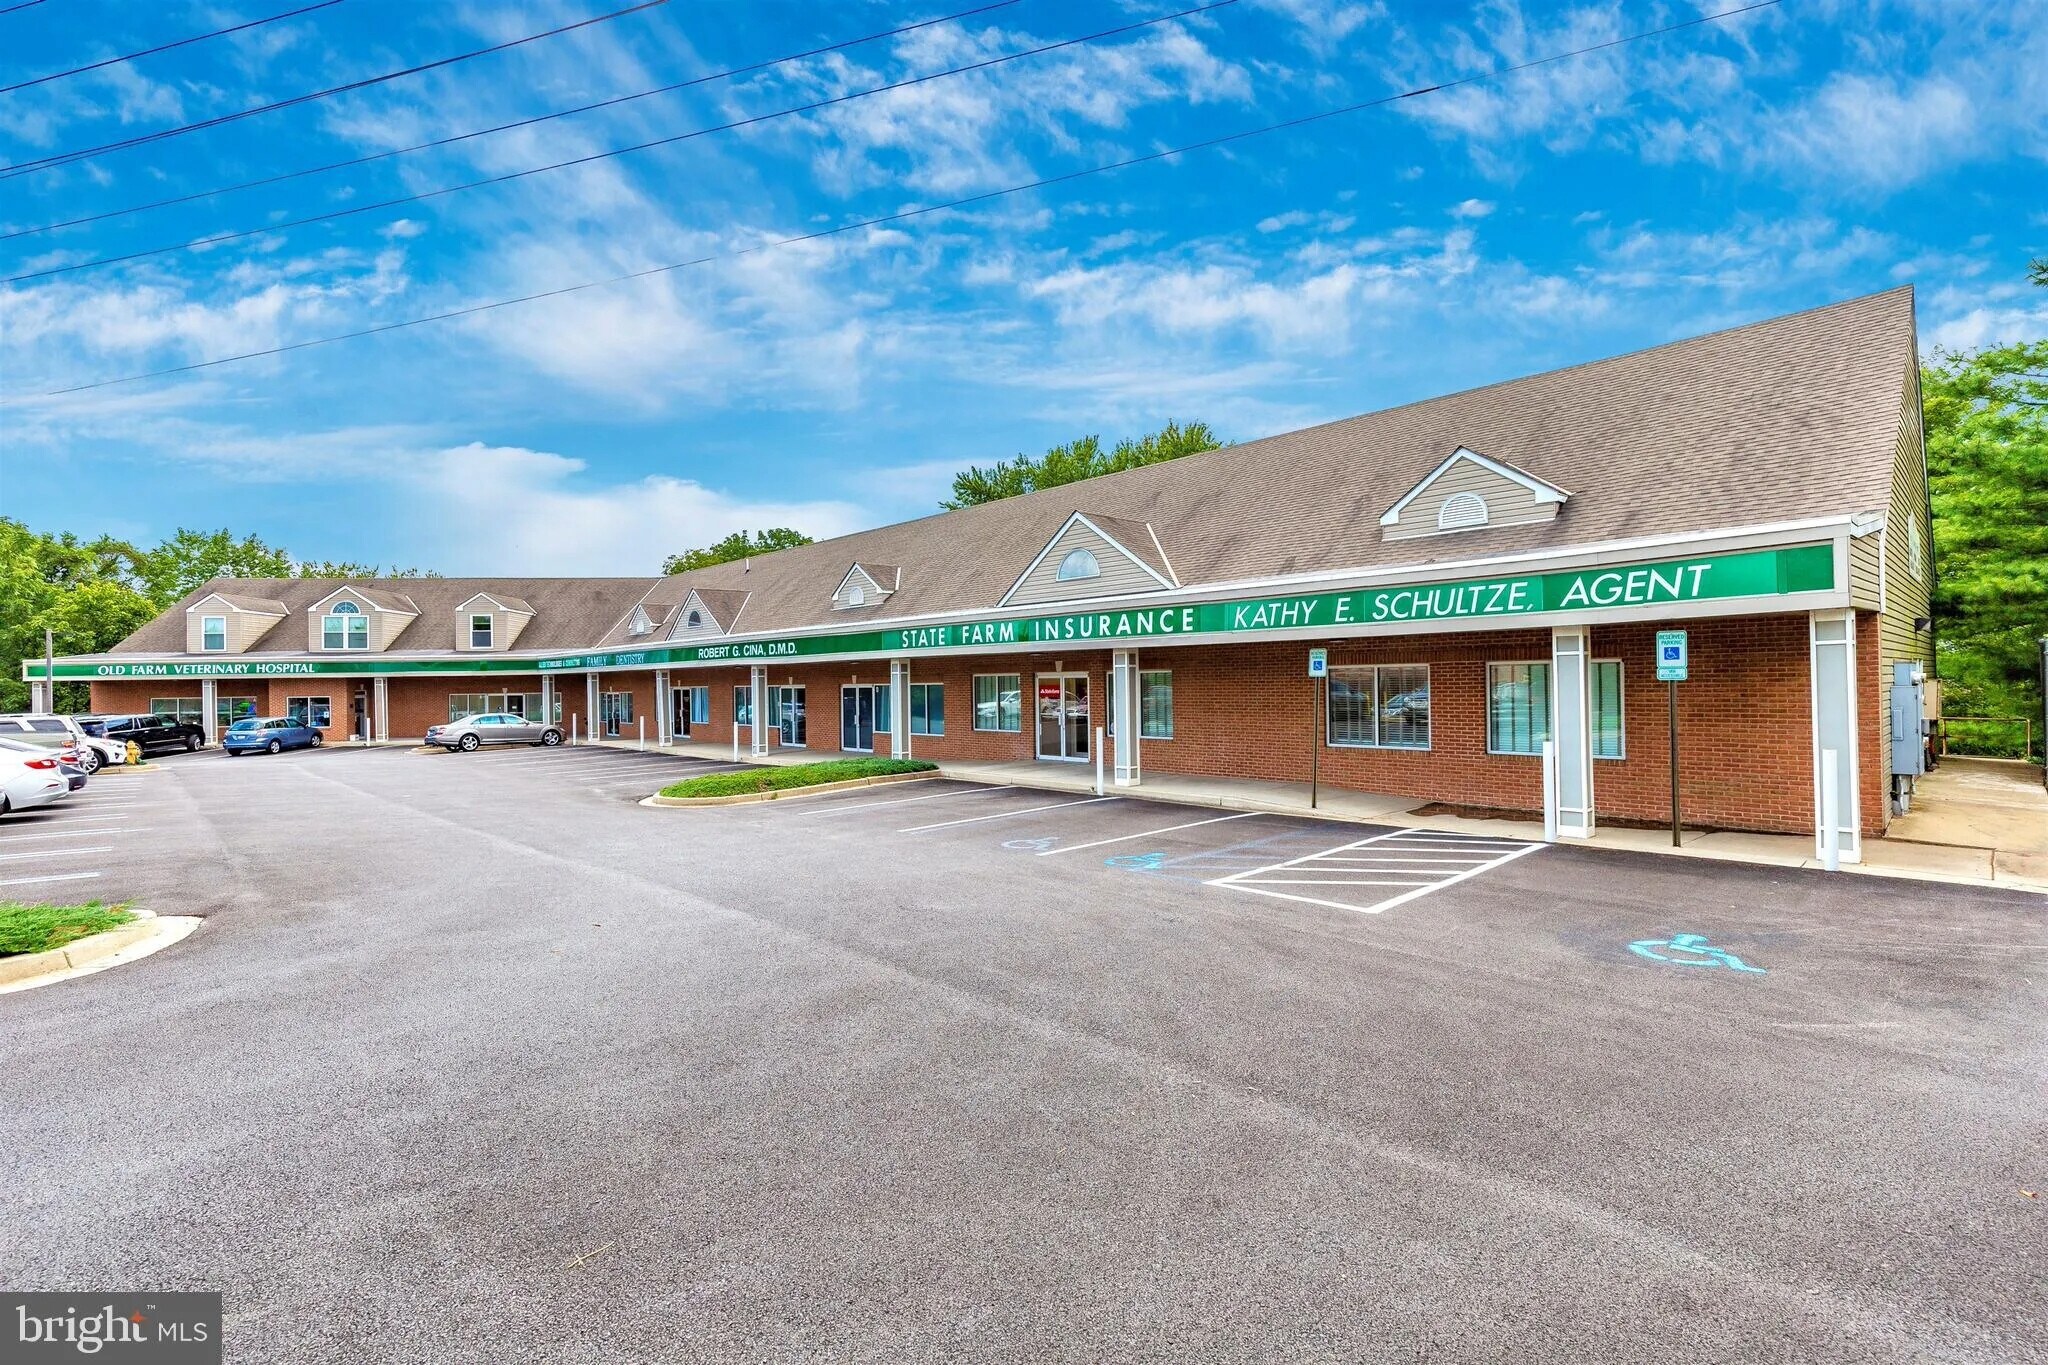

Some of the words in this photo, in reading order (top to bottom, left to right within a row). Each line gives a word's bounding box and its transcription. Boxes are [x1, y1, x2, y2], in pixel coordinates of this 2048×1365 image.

[1234, 600, 1318, 629] KATHY
[1334, 597, 1355, 623] E.
[1372, 581, 1535, 620] SCHULTZE,
[1560, 564, 1712, 607] AGENT
[902, 627, 946, 648] STATE
[962, 622, 1014, 644] FARM
[1035, 608, 1194, 641] INSURANCE
[698, 646, 730, 659] ROBERT
[732, 645, 741, 657] G.
[743, 644, 767, 657] CINA,
[768, 642, 798, 656] D.M.D.
[587, 656, 608, 667] FAMILY
[616, 653, 645, 665] DENTISTRY
[98, 665, 125, 676] OLD
[131, 665, 167, 675] FARM
[174, 664, 250, 675] VETERINARY
[256, 663, 315, 674] HOSPITAL
